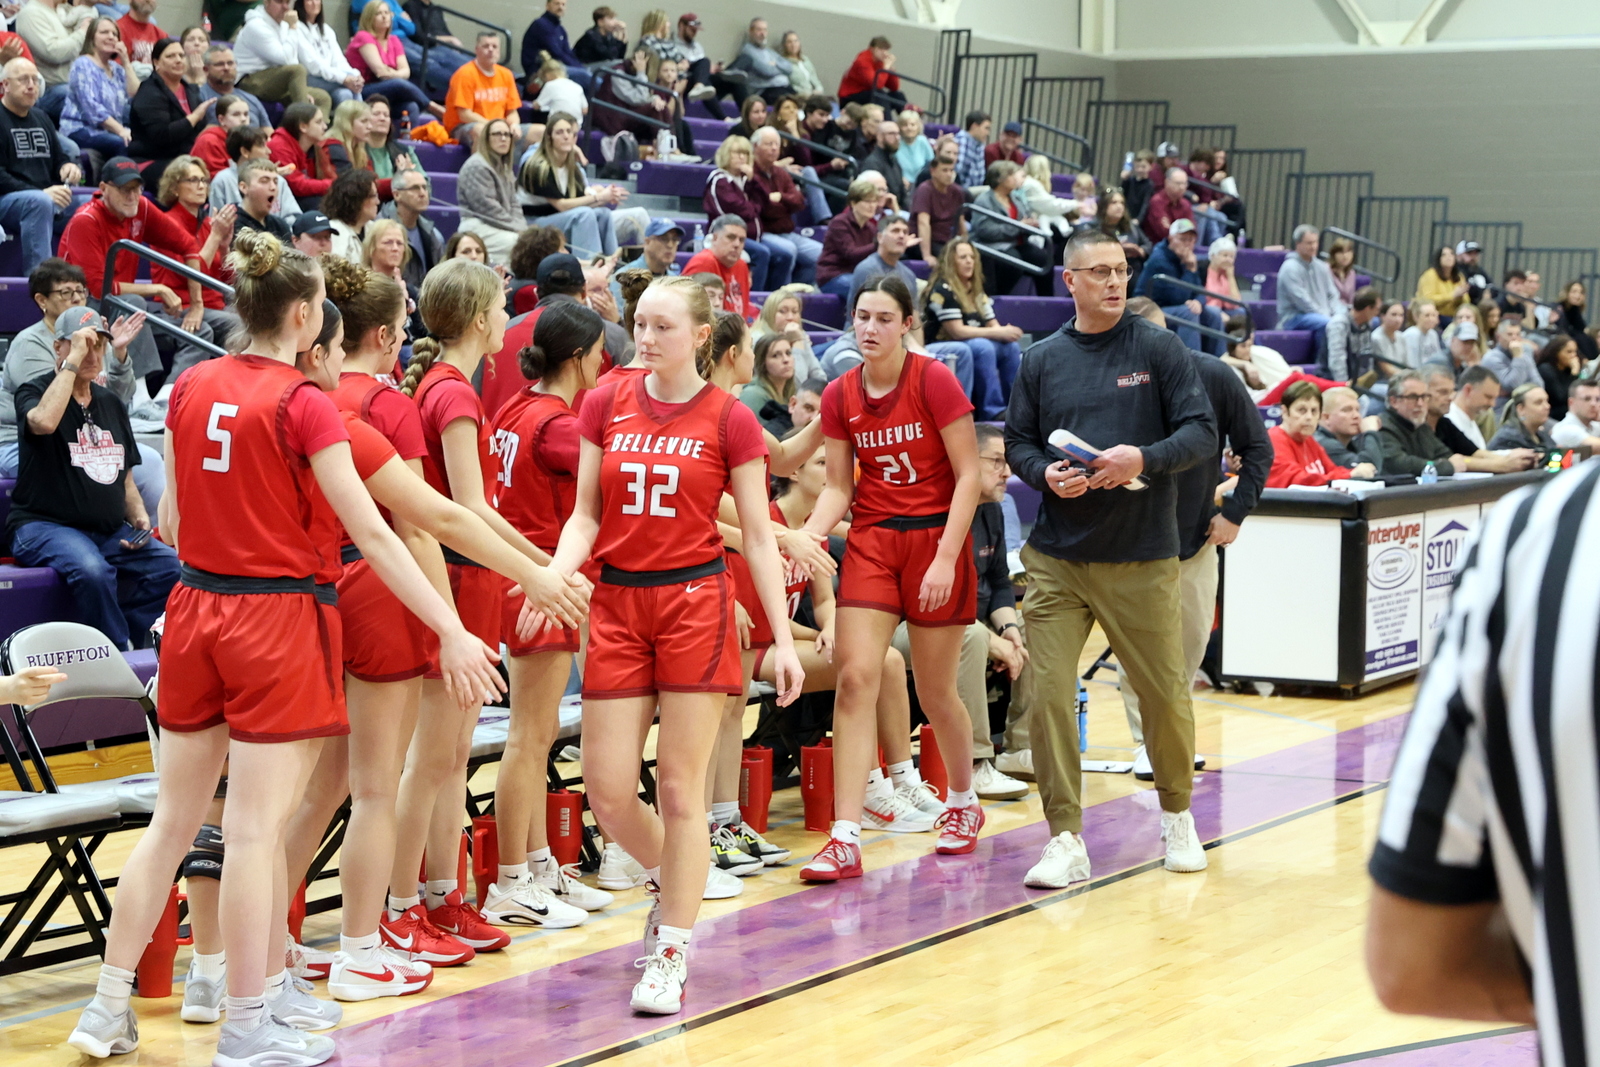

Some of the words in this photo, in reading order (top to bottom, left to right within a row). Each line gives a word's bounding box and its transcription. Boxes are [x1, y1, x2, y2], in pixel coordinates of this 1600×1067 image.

[202, 401, 240, 474] 5
[610, 432, 705, 459] BELLEVUE
[854, 421, 924, 448] BELLEVUE
[874, 451, 917, 485] 21
[619, 461, 680, 518] 32
[1426, 537, 1460, 571] STO
[26, 645, 110, 668] BLUFFTON
[559, 807, 571, 837] VALKO
